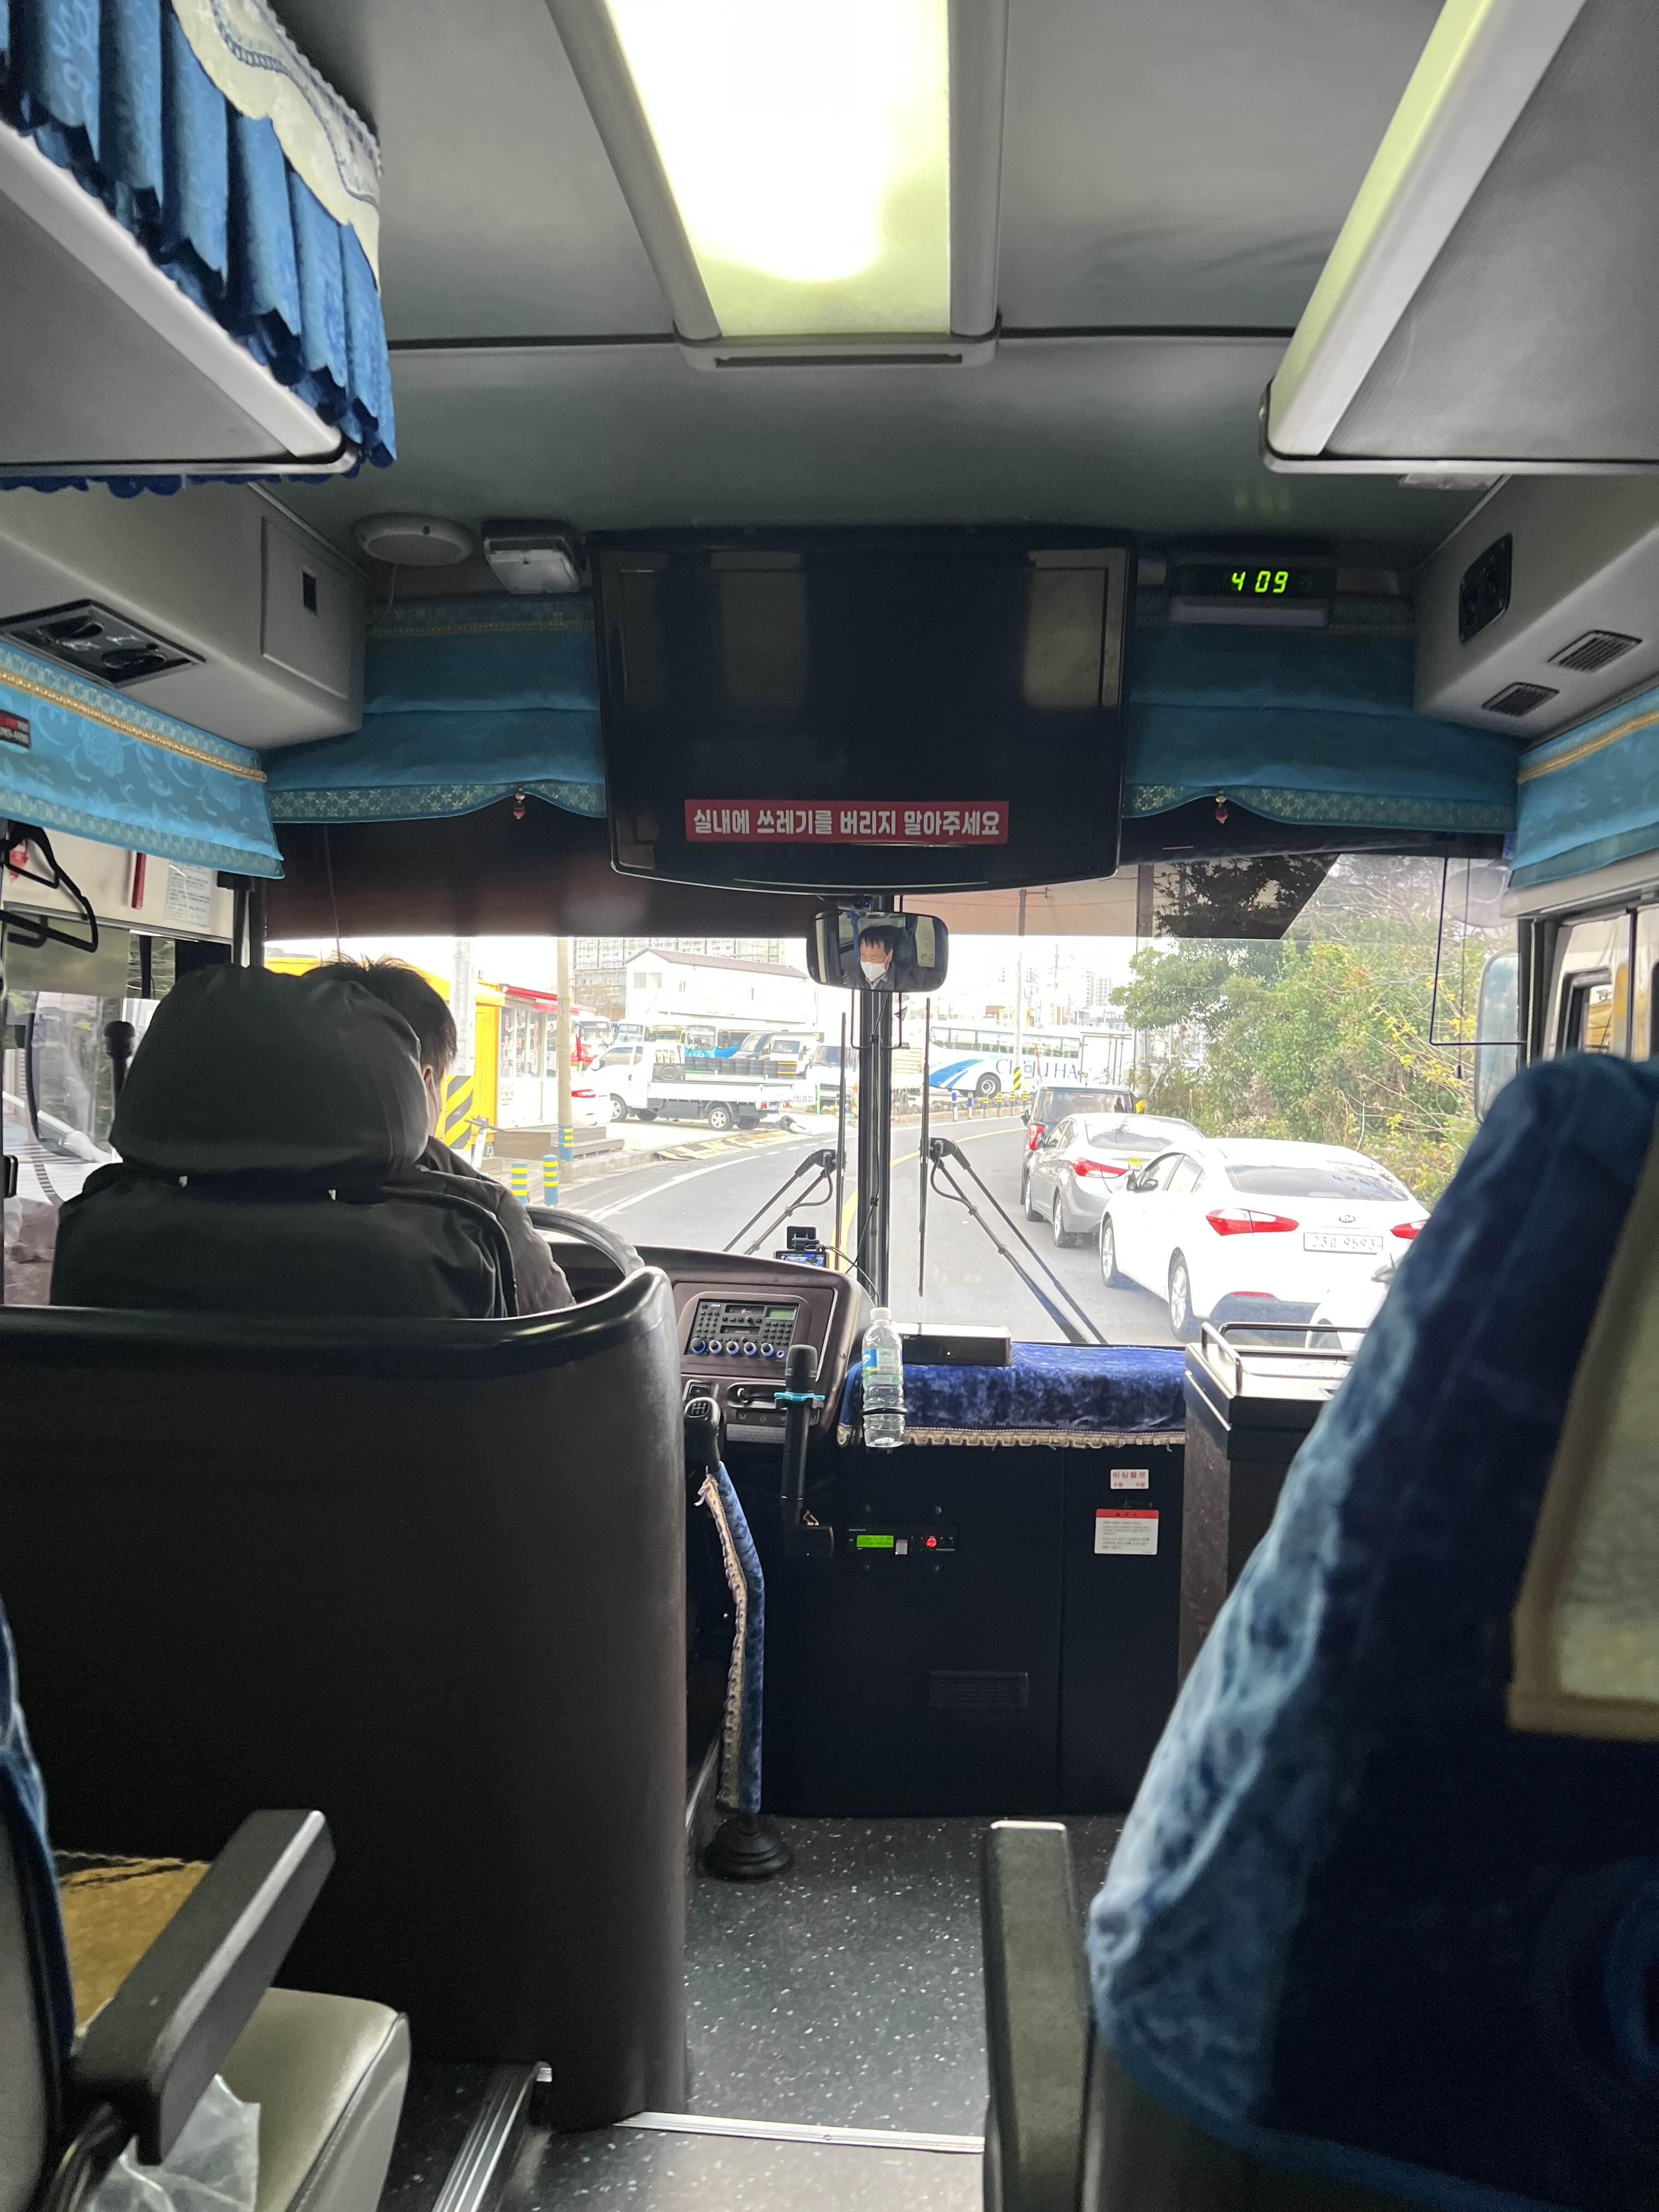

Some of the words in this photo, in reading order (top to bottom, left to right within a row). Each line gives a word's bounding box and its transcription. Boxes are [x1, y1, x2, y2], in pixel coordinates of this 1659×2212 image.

[693, 808, 750, 834] 실내에
[757, 809, 833, 835] 쓰레기를
[840, 809, 896, 836] 버리지
[904, 810, 1000, 837] 말아주세요
